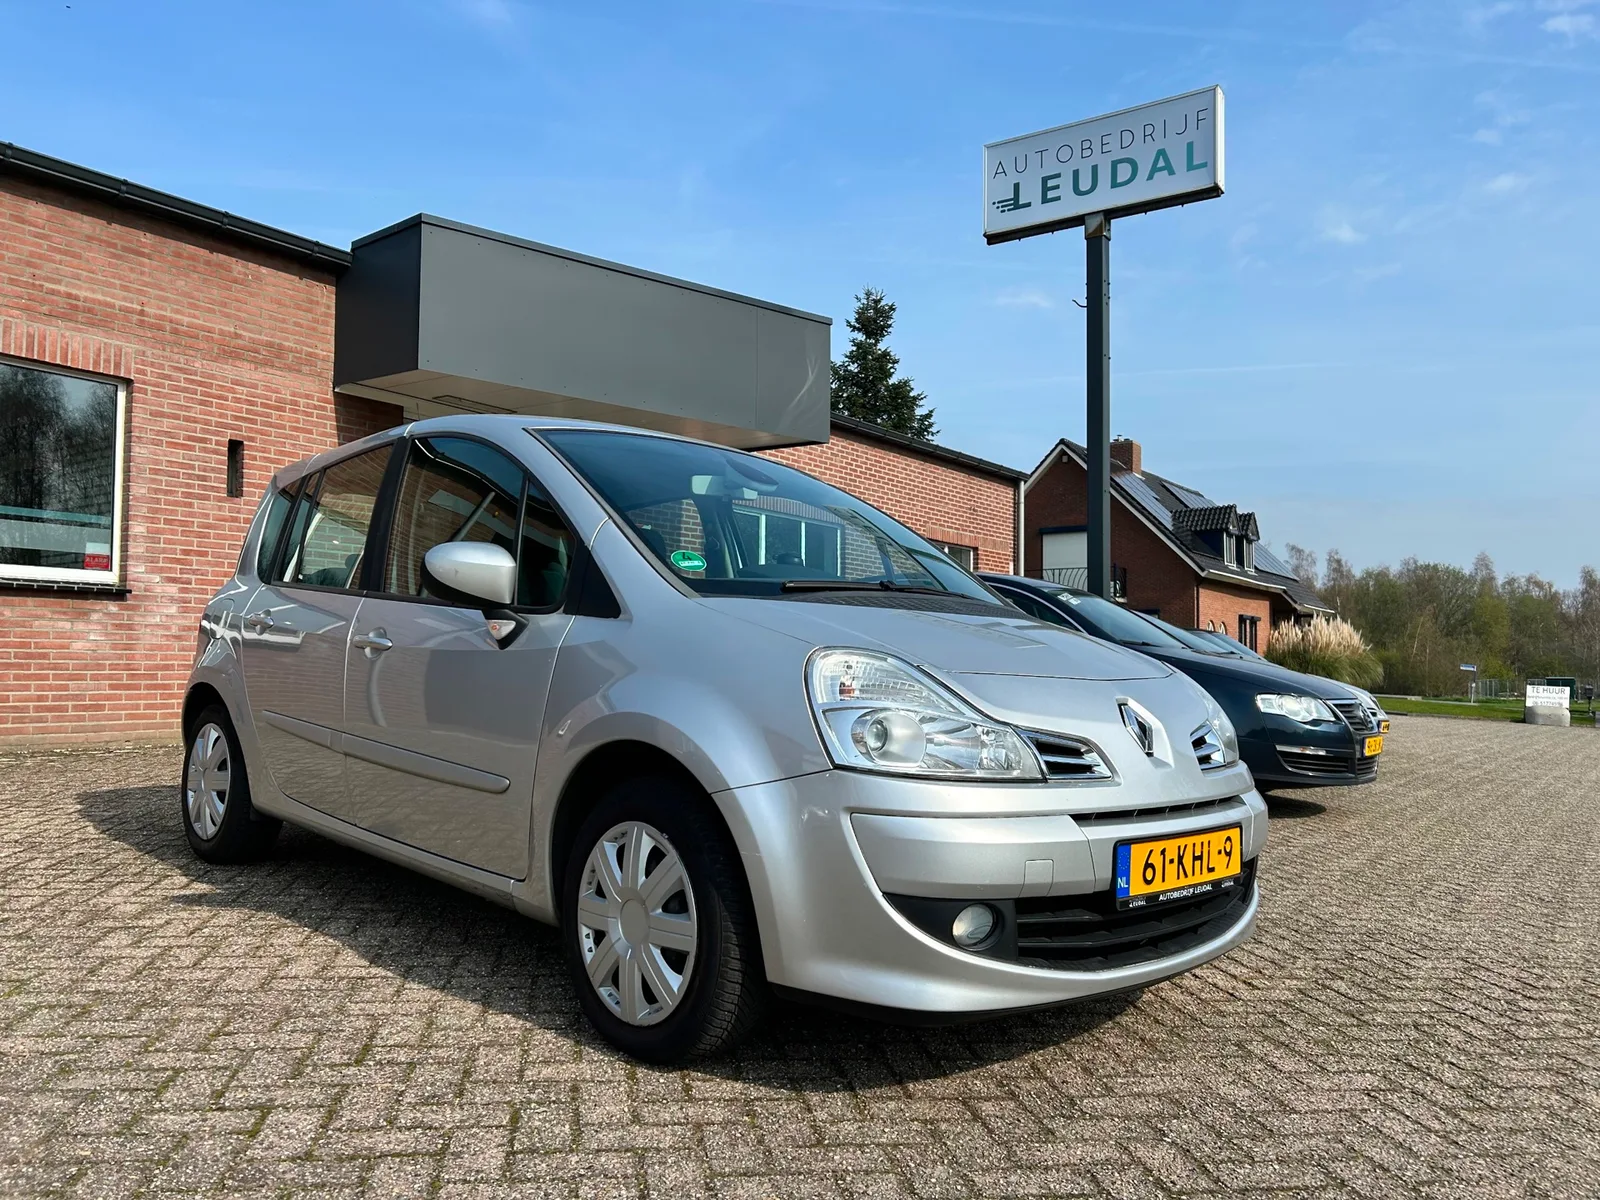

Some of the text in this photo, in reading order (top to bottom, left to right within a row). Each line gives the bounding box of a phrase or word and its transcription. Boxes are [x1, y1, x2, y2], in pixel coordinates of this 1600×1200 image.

[992, 107, 1209, 179] AUTOBEDRIJF
[1005, 140, 1208, 211] LEUDAL
[1531, 686, 1566, 695] TE HUUR
[1142, 835, 1233, 886] 61-KHL-9
[1117, 877, 1129, 889] NL
[1158, 887, 1194, 901] AUTOBEDRIJF
[1194, 883, 1213, 894] LEUDAL
